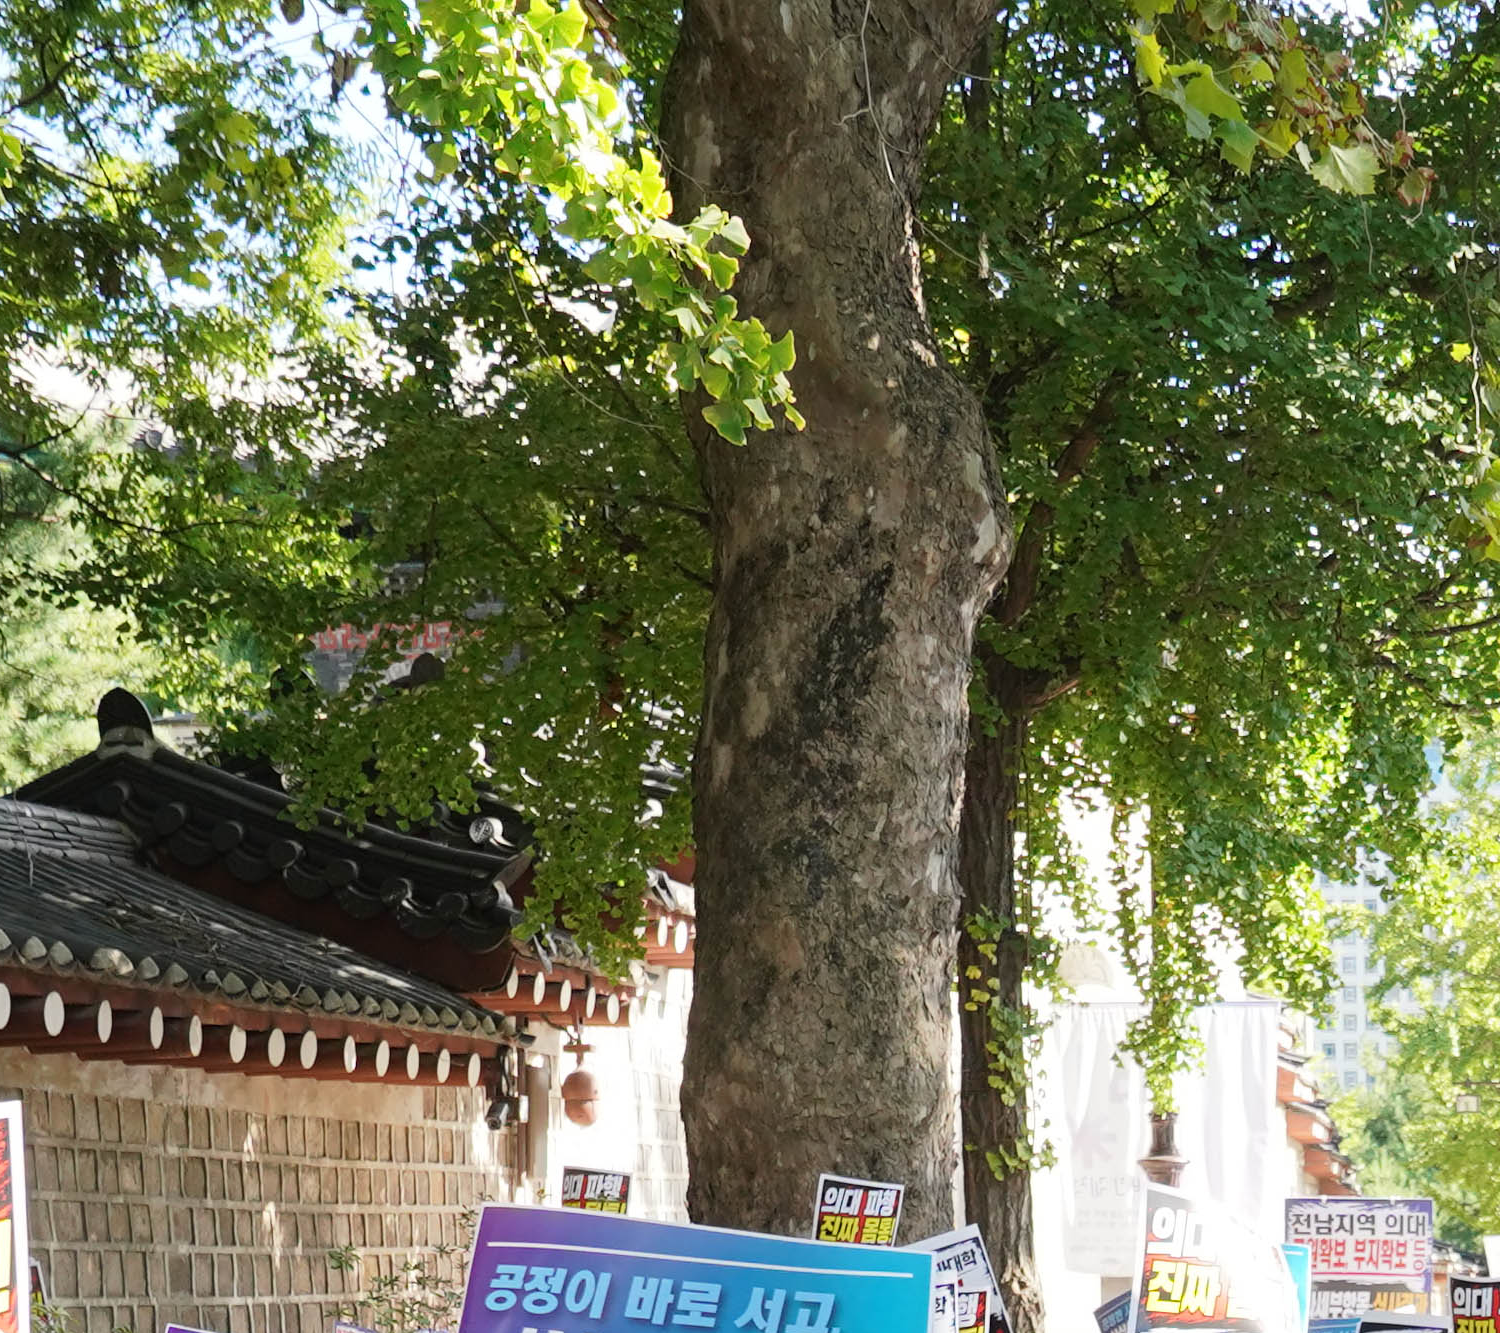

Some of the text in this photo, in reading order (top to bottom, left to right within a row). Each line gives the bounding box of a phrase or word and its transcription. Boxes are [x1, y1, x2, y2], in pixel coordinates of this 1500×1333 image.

[822, 1186, 897, 1217] 의대 파행
[819, 1215, 860, 1241] 진짜
[1291, 1213, 1425, 1235] 전남지역 의대
[485, 1264, 611, 1320] 공정이
[627, 1274, 722, 1329] 바로
[1453, 1288, 1493, 1318] 의대
